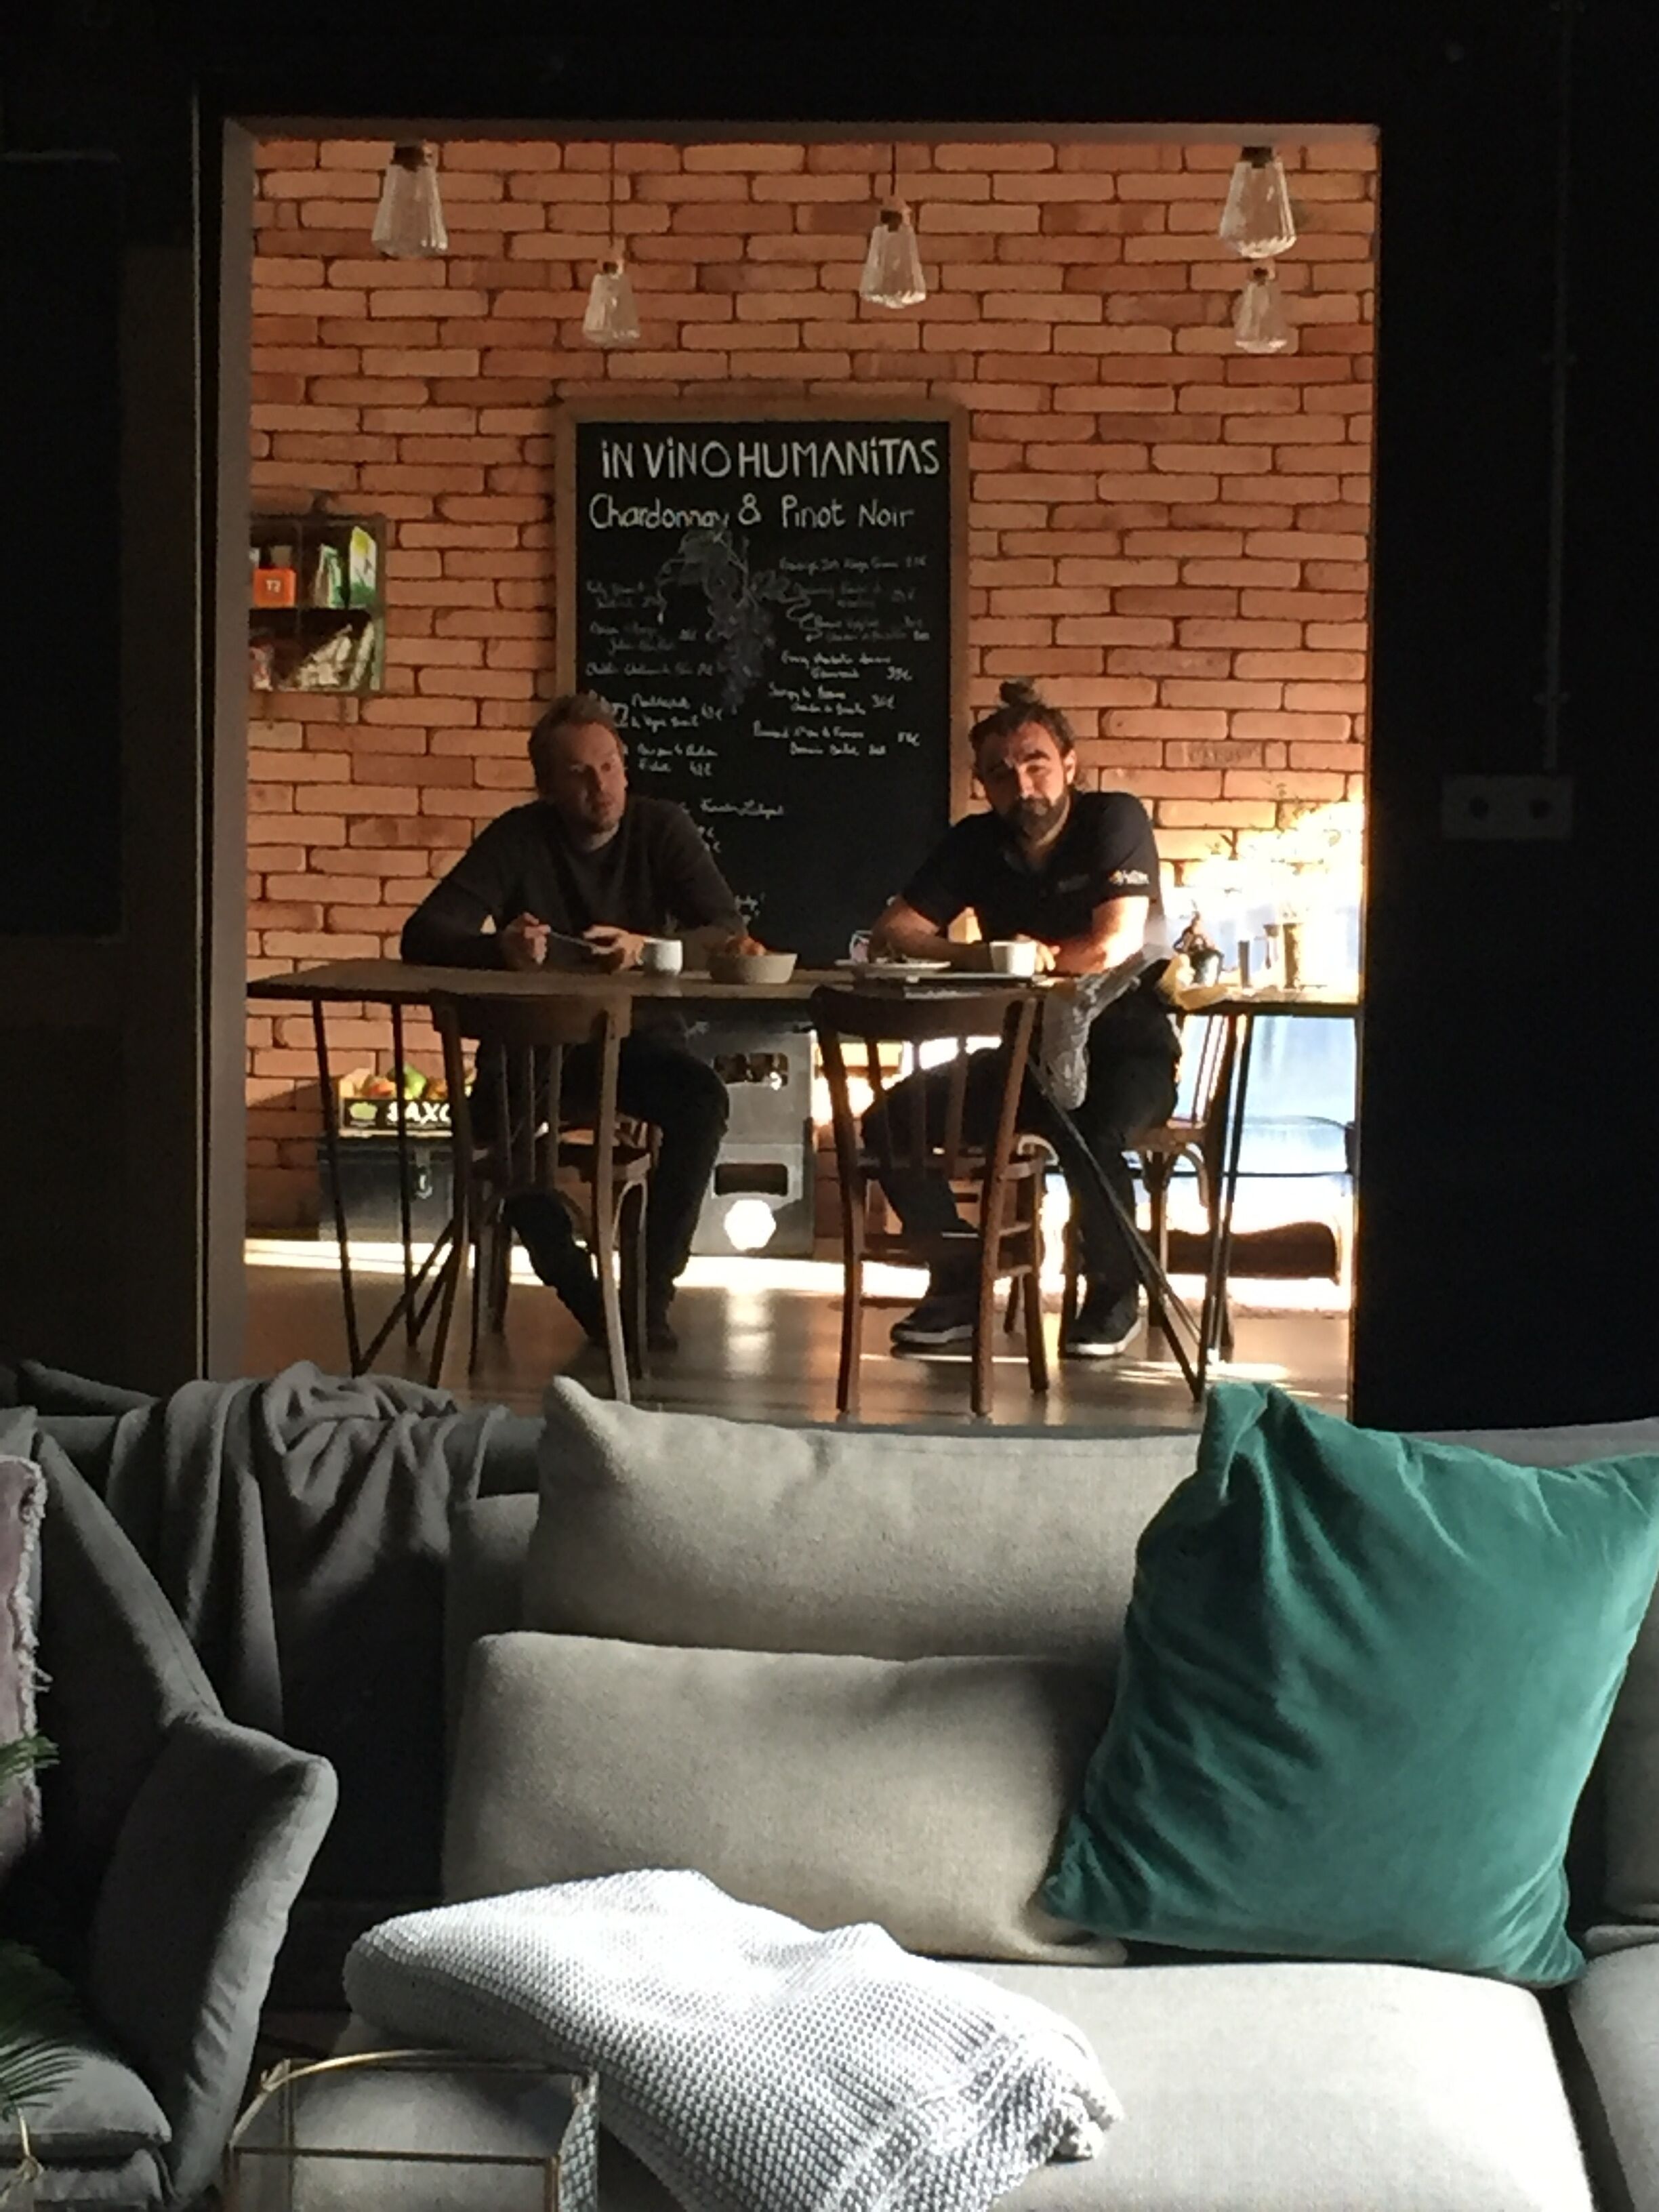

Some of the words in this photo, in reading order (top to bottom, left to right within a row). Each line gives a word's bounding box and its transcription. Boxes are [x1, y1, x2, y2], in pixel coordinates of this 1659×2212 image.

[589, 493, 729, 529] Chardonnay
[738, 493, 761, 525] &
[781, 494, 845, 528] Pinot
[859, 499, 915, 527] Noir
